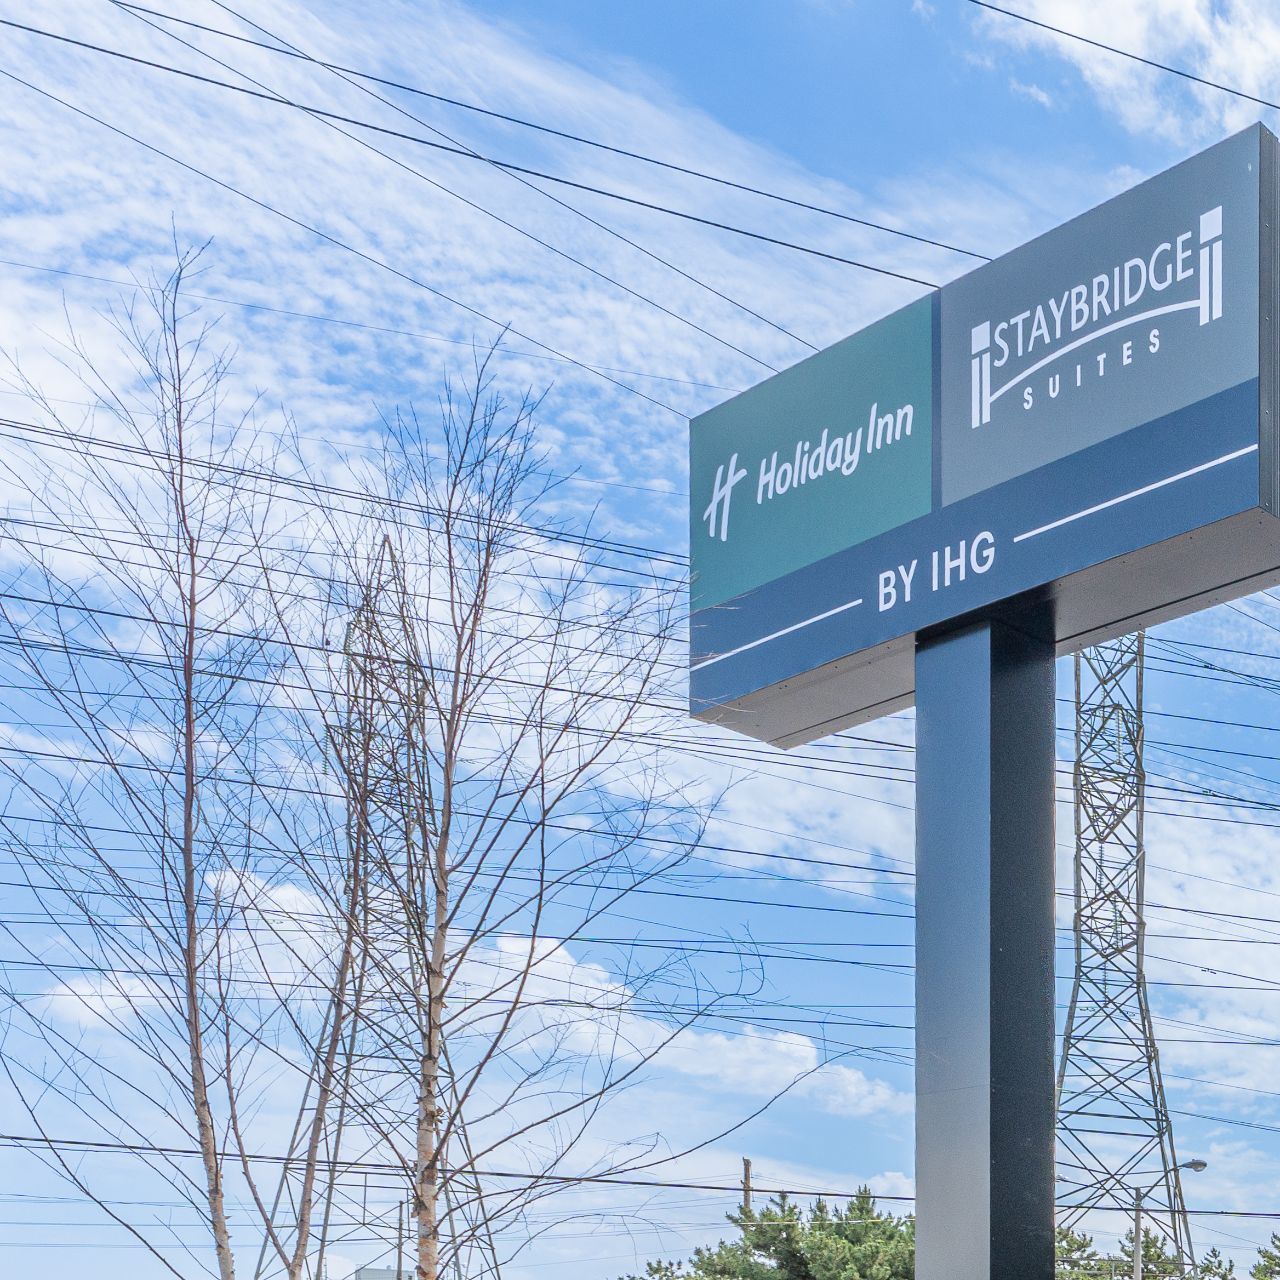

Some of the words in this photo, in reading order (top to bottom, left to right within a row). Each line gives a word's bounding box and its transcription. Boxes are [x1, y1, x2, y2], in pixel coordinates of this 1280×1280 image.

[994, 231, 1194, 367] STAYBRIDGE
[1023, 328, 1160, 410] SUITES
[756, 428, 861, 504] Holiday
[866, 402, 914, 444] Inn
[878, 559, 919, 612] BY
[932, 531, 996, 591] IHG
